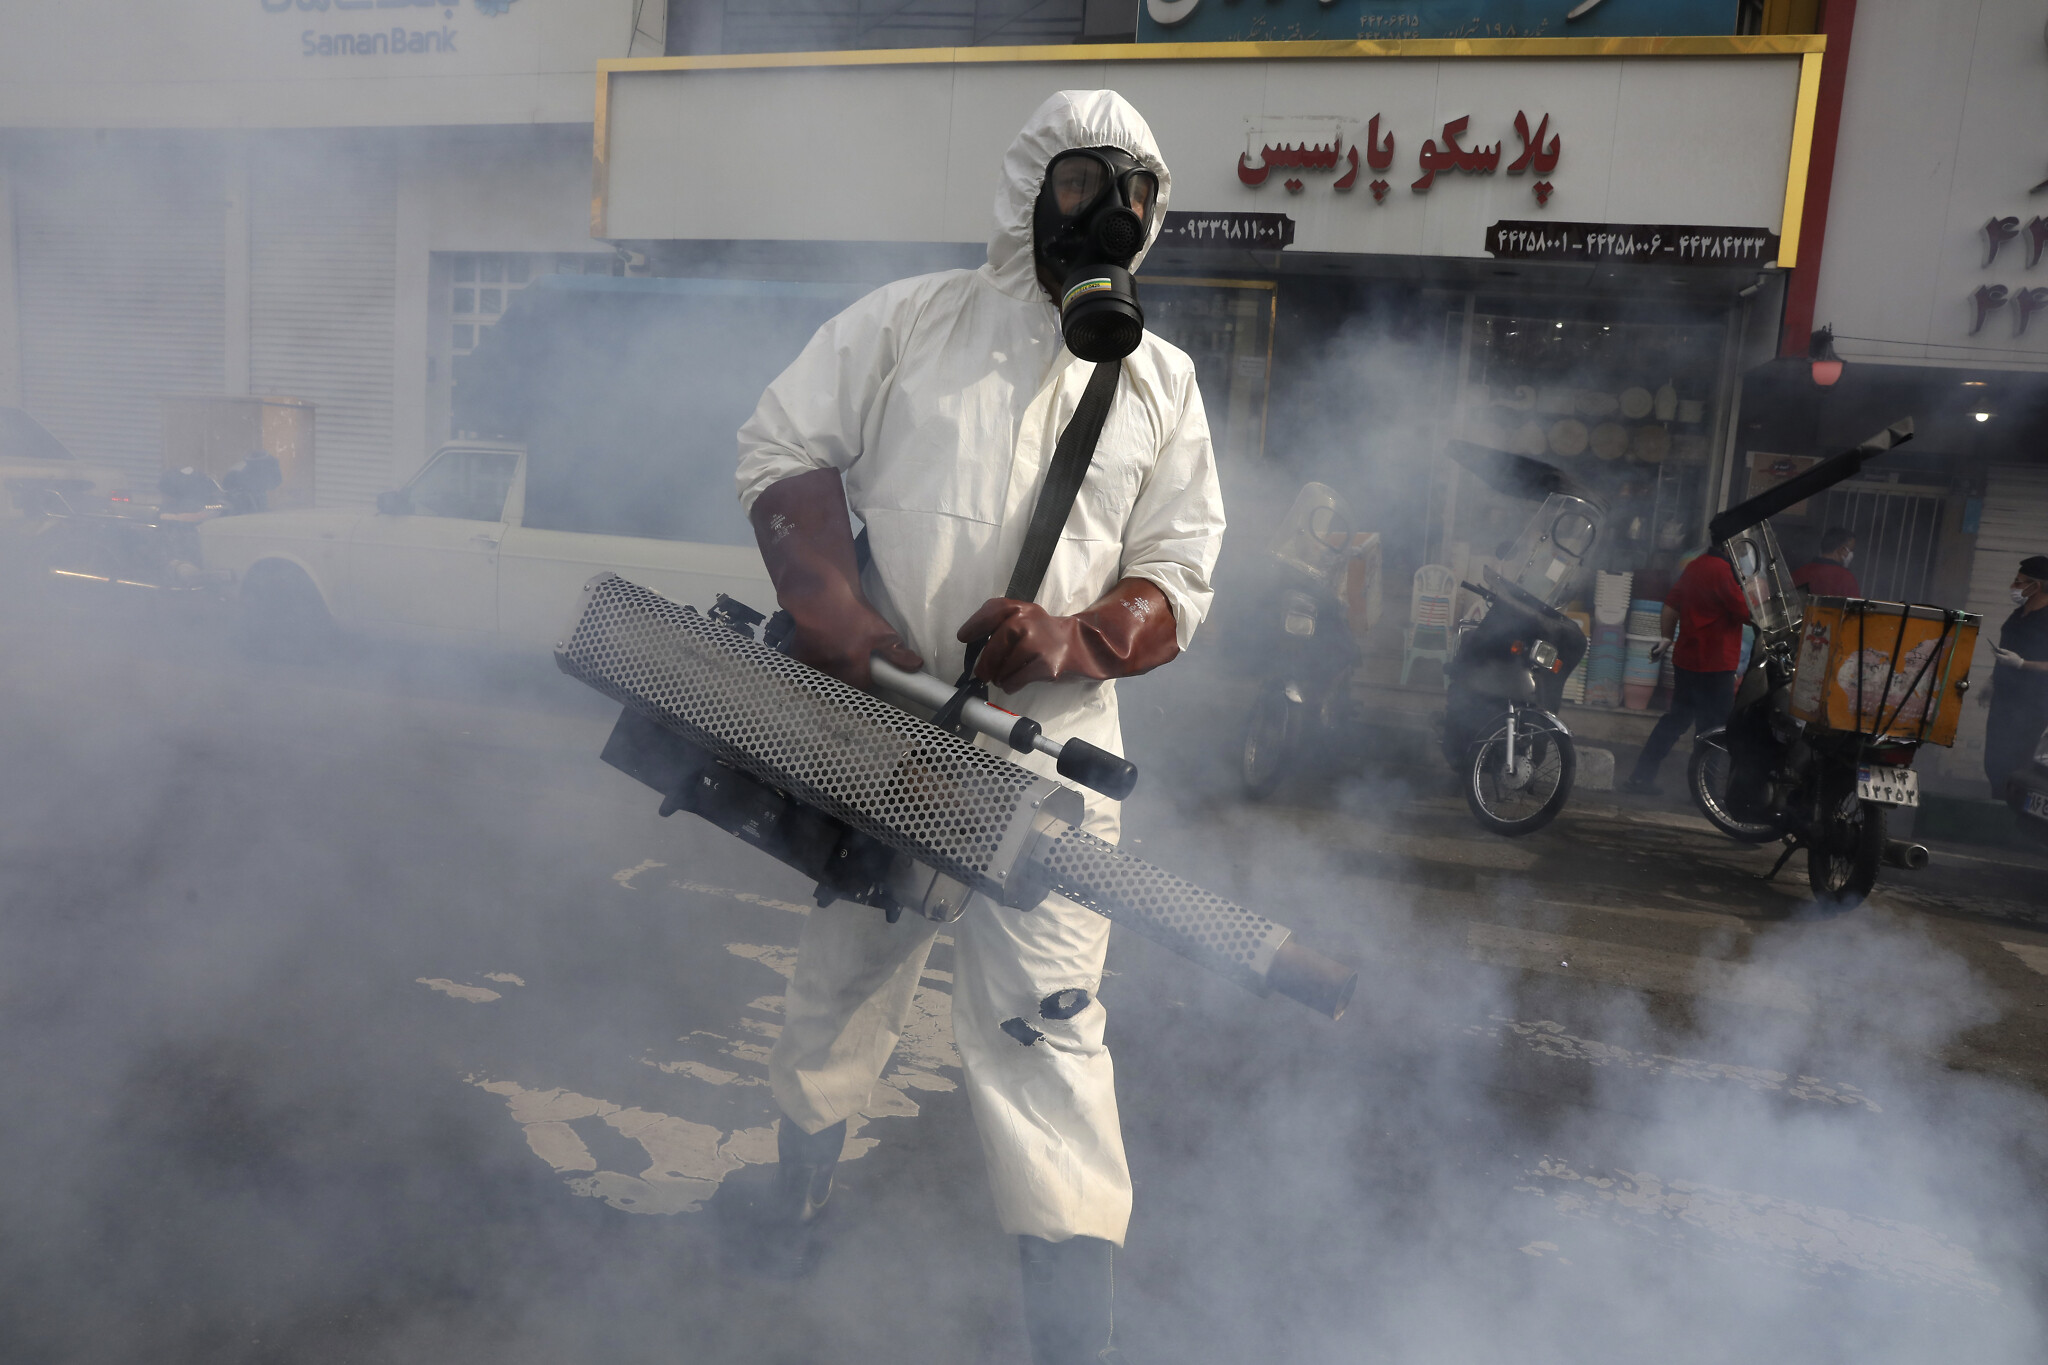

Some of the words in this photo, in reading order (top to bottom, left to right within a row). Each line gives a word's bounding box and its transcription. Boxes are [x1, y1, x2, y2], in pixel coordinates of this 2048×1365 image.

[1238, 112, 1394, 202] پارسیس
[1411, 110, 1561, 206] پلاسکو
[1179, 219, 1283, 240] ۰۹۳۳۹۸۱۱۰۰۱
[1498, 229, 1568, 253] ۴۴۲۵۸۰۰۱
[1586, 232, 1661, 256] ۴۴۲۵۸۰۰۶
[1679, 235, 1766, 259] ۴۴۳۸۴۲۳۳
[1863, 783, 1915, 803] ۱۳۴۵۳
